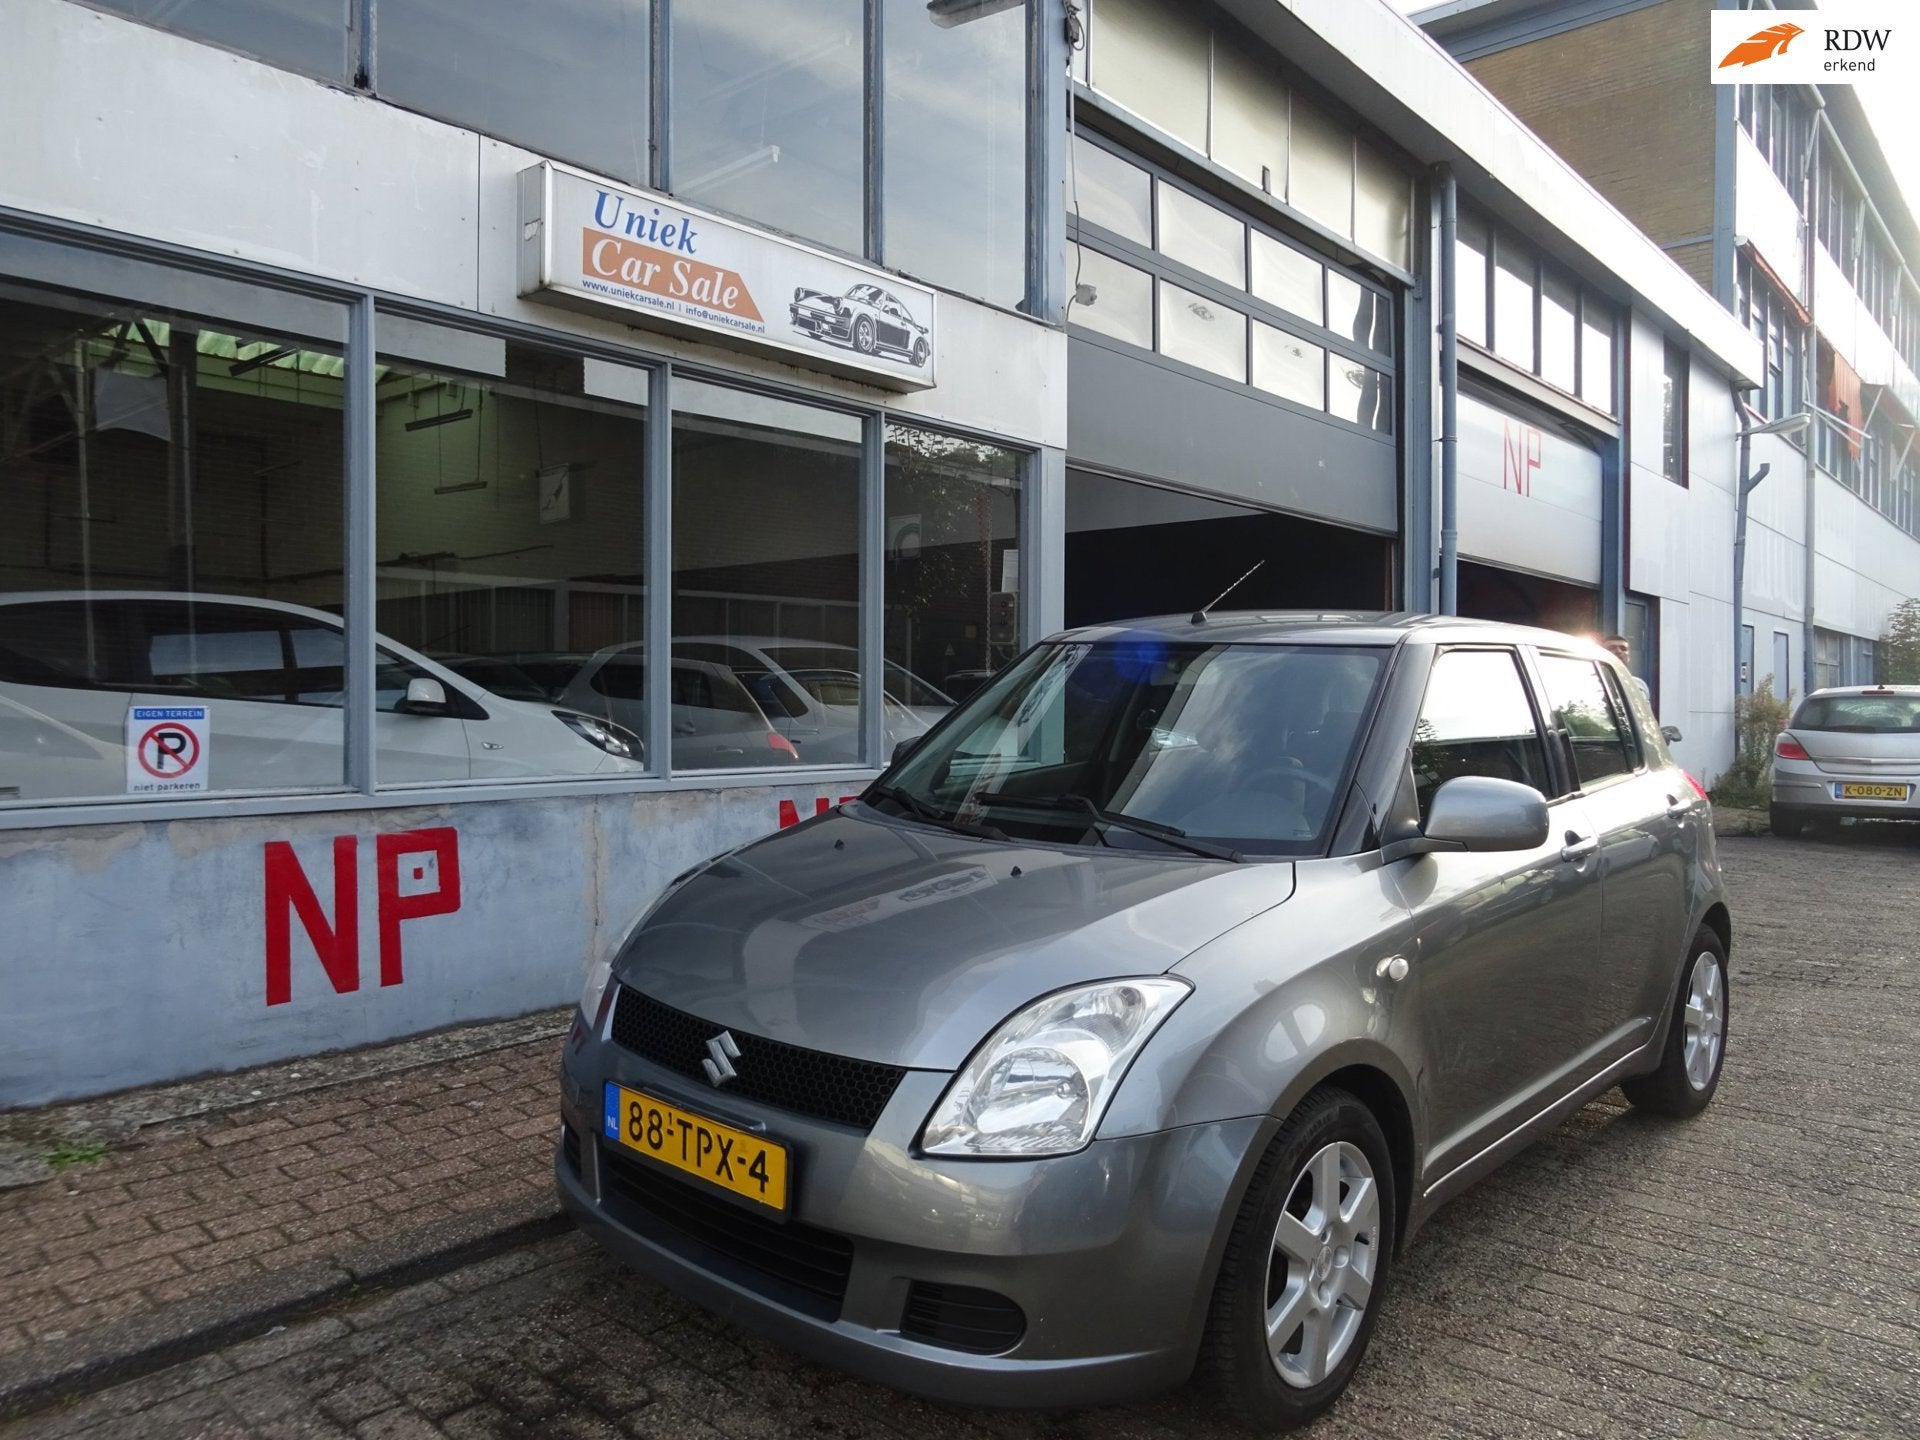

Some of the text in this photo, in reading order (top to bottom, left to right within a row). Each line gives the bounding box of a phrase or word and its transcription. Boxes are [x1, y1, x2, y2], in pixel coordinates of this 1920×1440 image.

[594, 190, 698, 254] Uniek
[591, 239, 740, 309] Car Sale
[582, 280, 675, 310] www.uniekcarsale.nl
[685, 304, 765, 333] info@uniekcarsale.nl
[1503, 419, 1541, 497] NP
[136, 710, 203, 718] EIGEN TERREIN
[133, 782, 201, 793] niet parkeren
[1844, 785, 1902, 797] K-080-ZN
[264, 826, 461, 1007] NP
[607, 1115, 619, 1130] NL
[628, 1101, 769, 1194] 88-TPX-4
